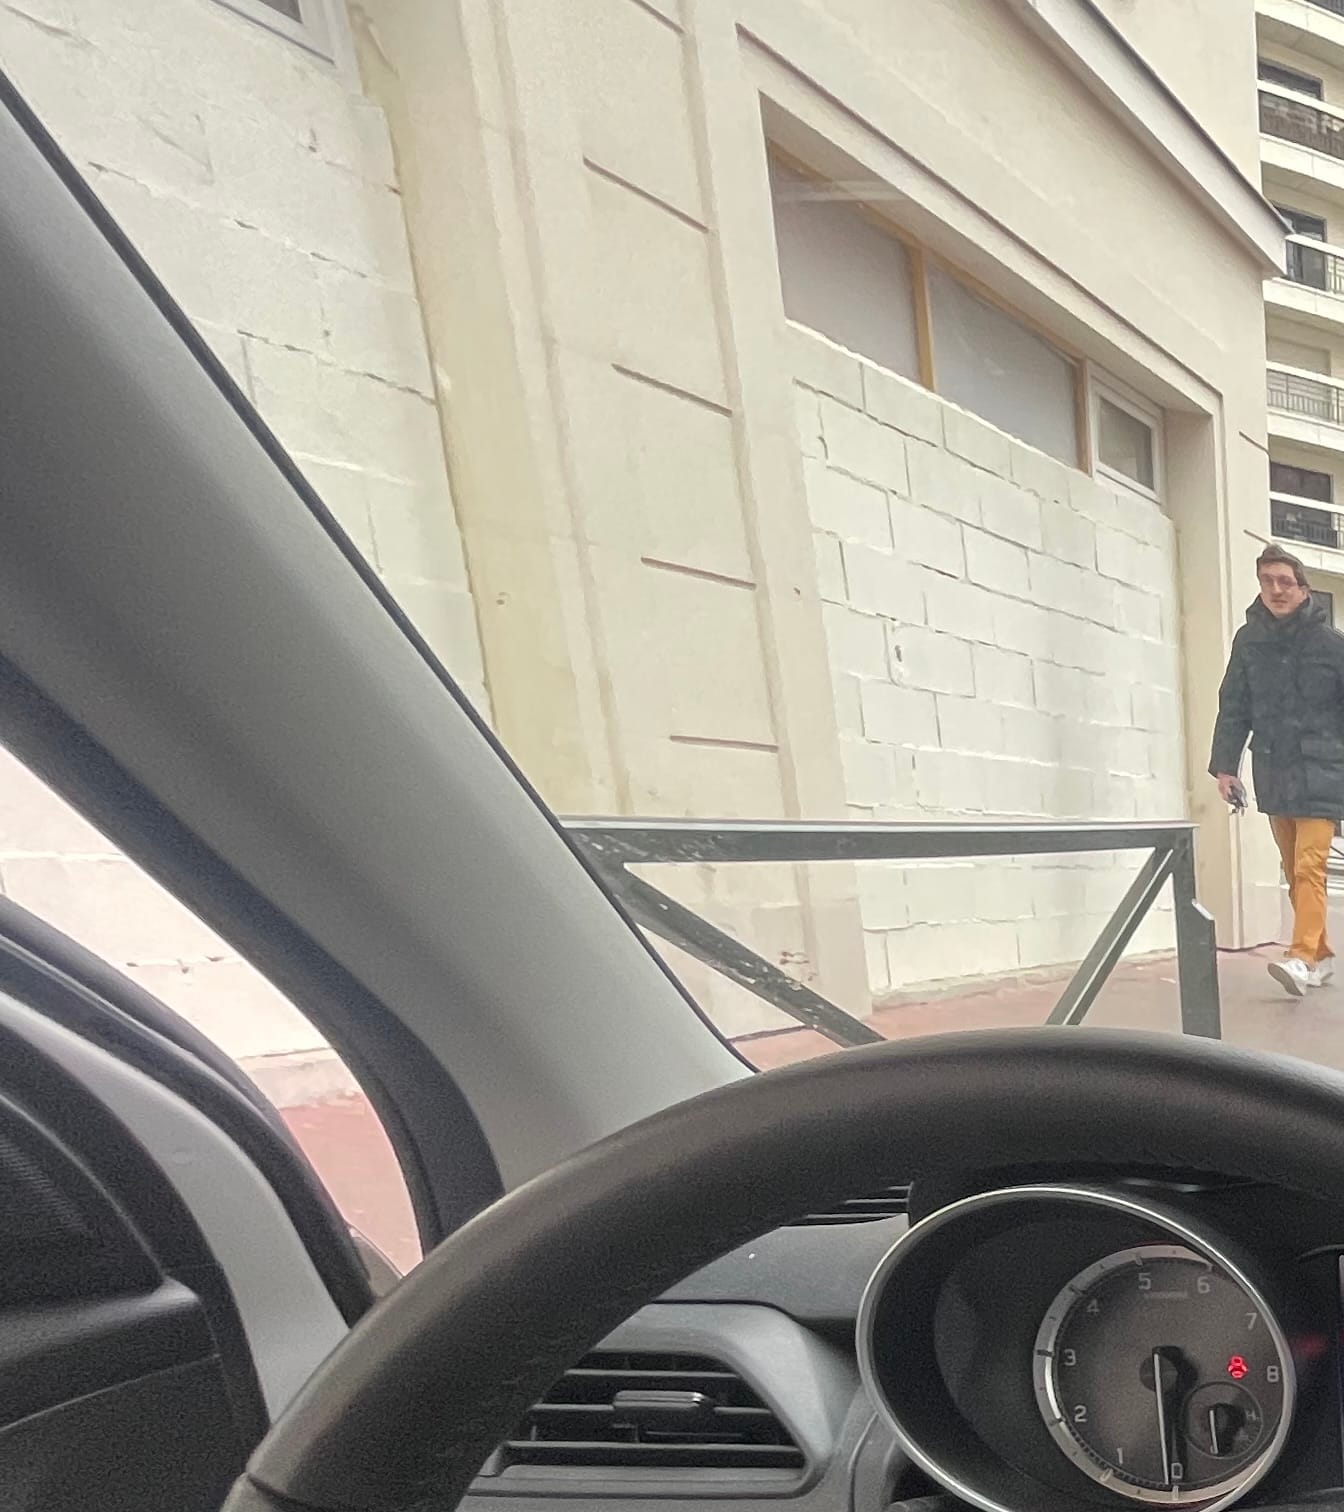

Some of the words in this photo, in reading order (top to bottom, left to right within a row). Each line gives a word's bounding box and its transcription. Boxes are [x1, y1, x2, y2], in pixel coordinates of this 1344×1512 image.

[1138, 1272, 1151, 1290] 5
[1196, 1276, 1211, 1294] 6
[1086, 1299, 1100, 1314] 4
[1244, 1311, 1258, 1330] 7
[1063, 1349, 1077, 1367] 3
[1265, 1364, 1280, 1384] 8
[1073, 1404, 1089, 1424] 2
[1114, 1446, 1124, 1465] 1
